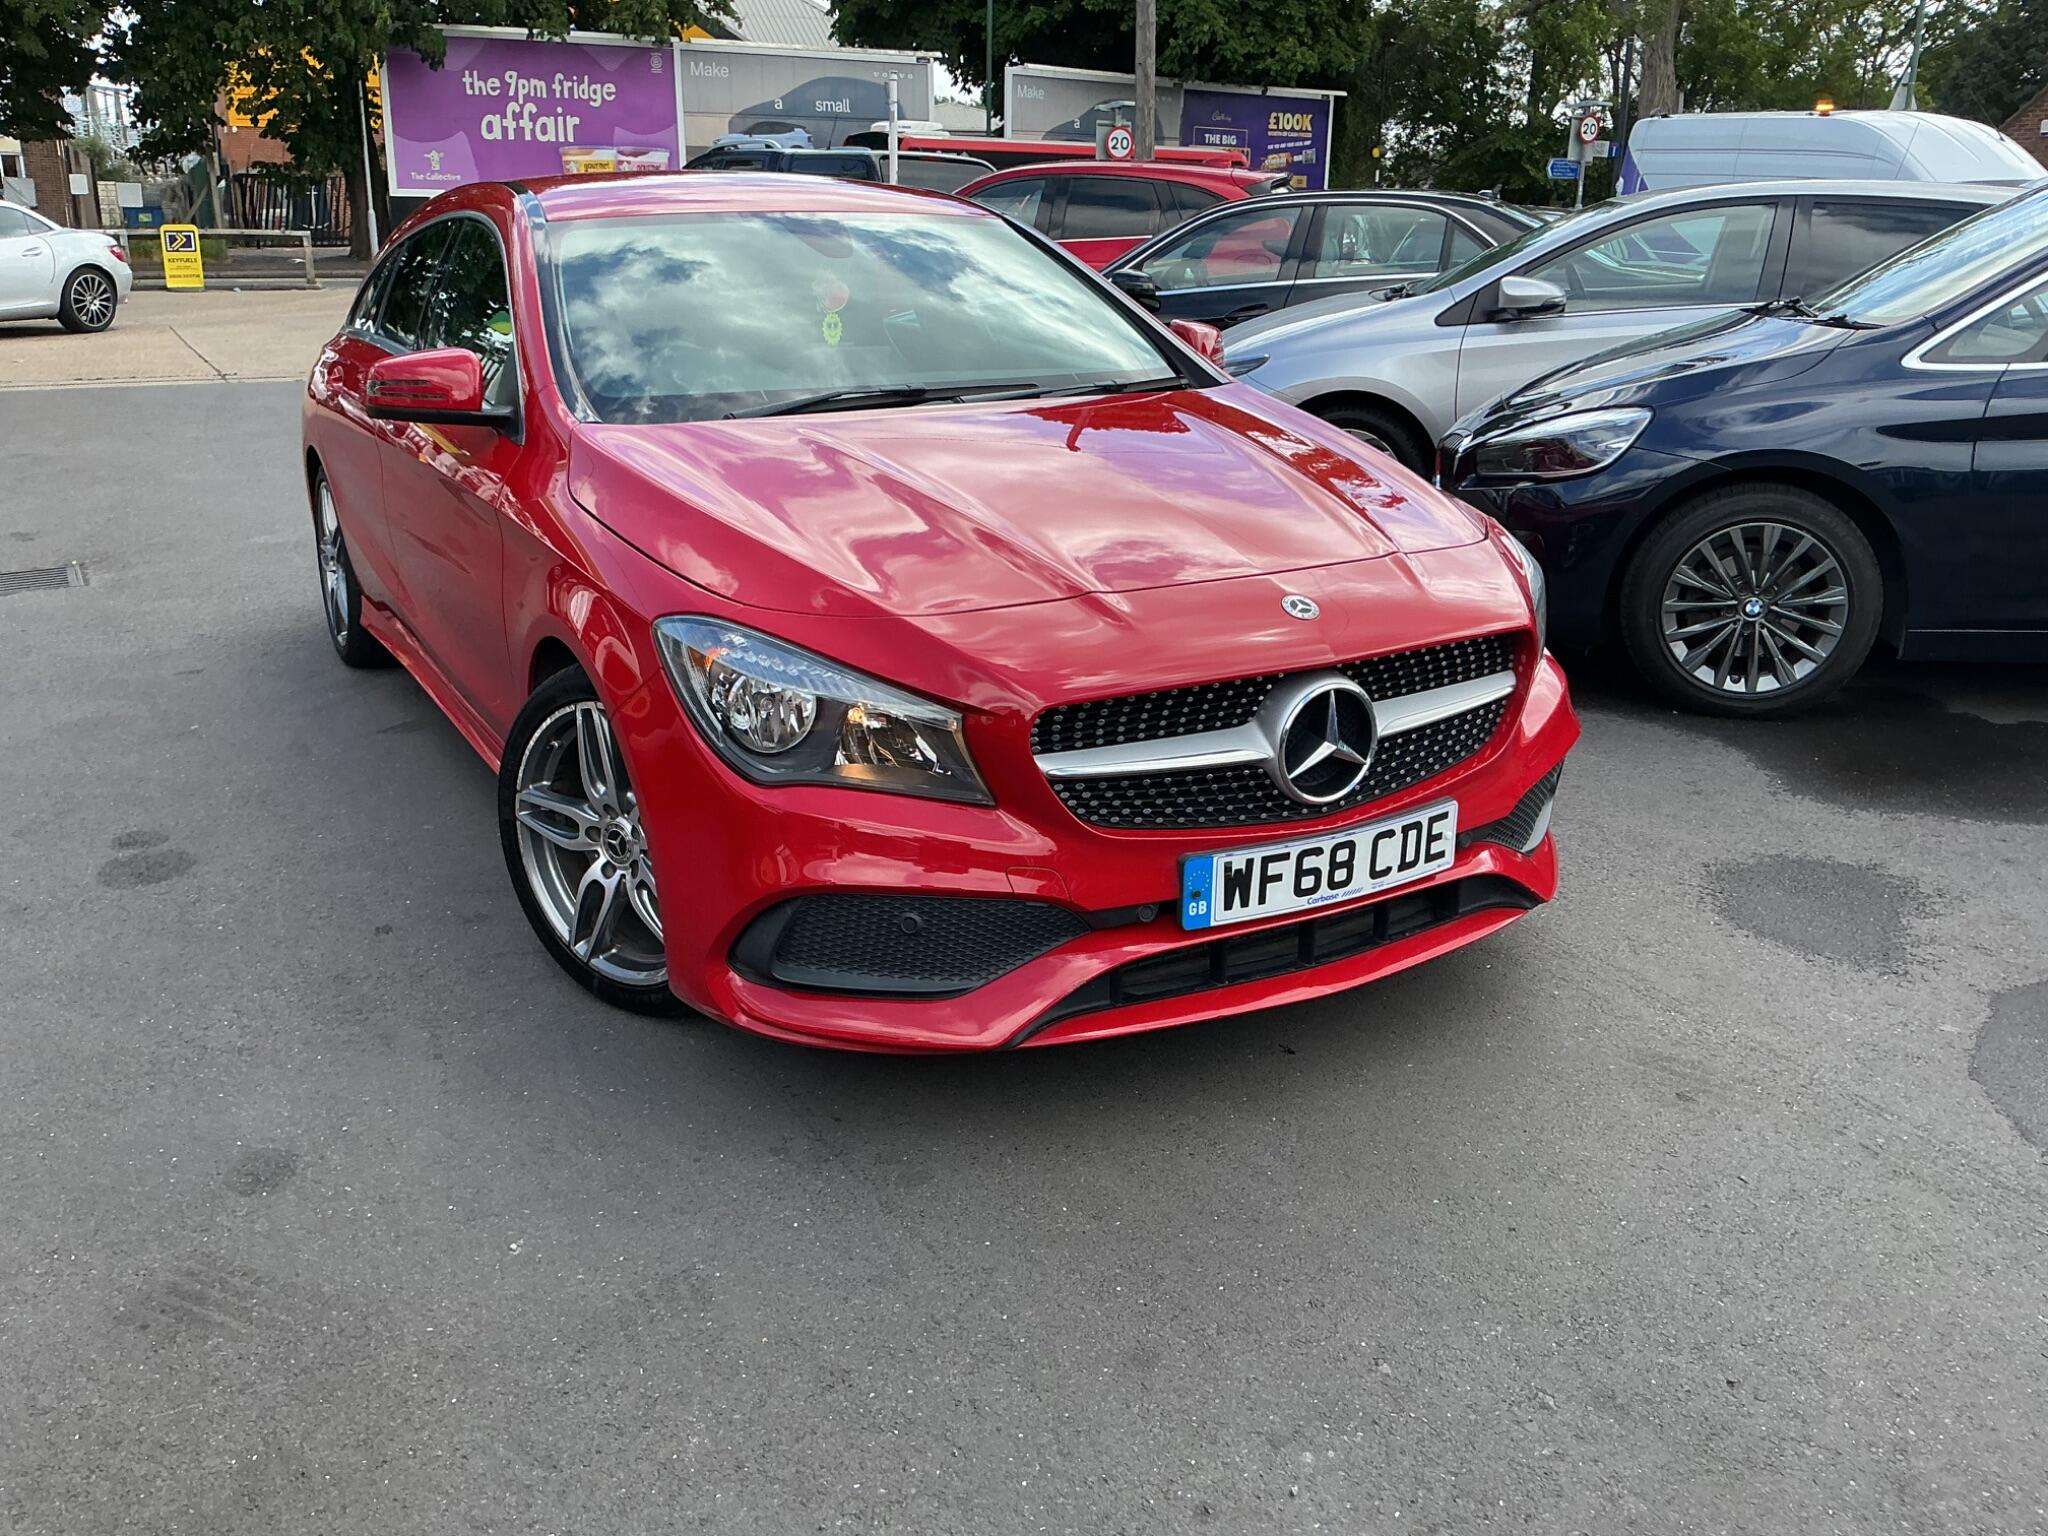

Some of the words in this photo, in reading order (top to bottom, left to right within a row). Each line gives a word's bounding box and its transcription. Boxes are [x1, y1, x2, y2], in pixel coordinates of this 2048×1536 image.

[690, 62, 729, 79] Make
[873, 71, 913, 80] VOVO
[462, 70, 501, 96] the
[504, 70, 547, 105] 9pm
[551, 72, 617, 107] fridge
[1016, 84, 1045, 99] Make
[774, 98, 783, 110] a
[815, 98, 851, 113] small
[480, 102, 580, 142] affair
[1073, 118, 1081, 129] a
[1267, 112, 1313, 132] £100K
[1583, 123, 1596, 135] 20
[1110, 136, 1130, 150] 20
[1204, 133, 1221, 144] THE
[1221, 134, 1237, 145] BIG
[1222, 839, 1357, 912] WF68
[1368, 810, 1450, 881] CDE
[1188, 900, 1208, 916] GB
